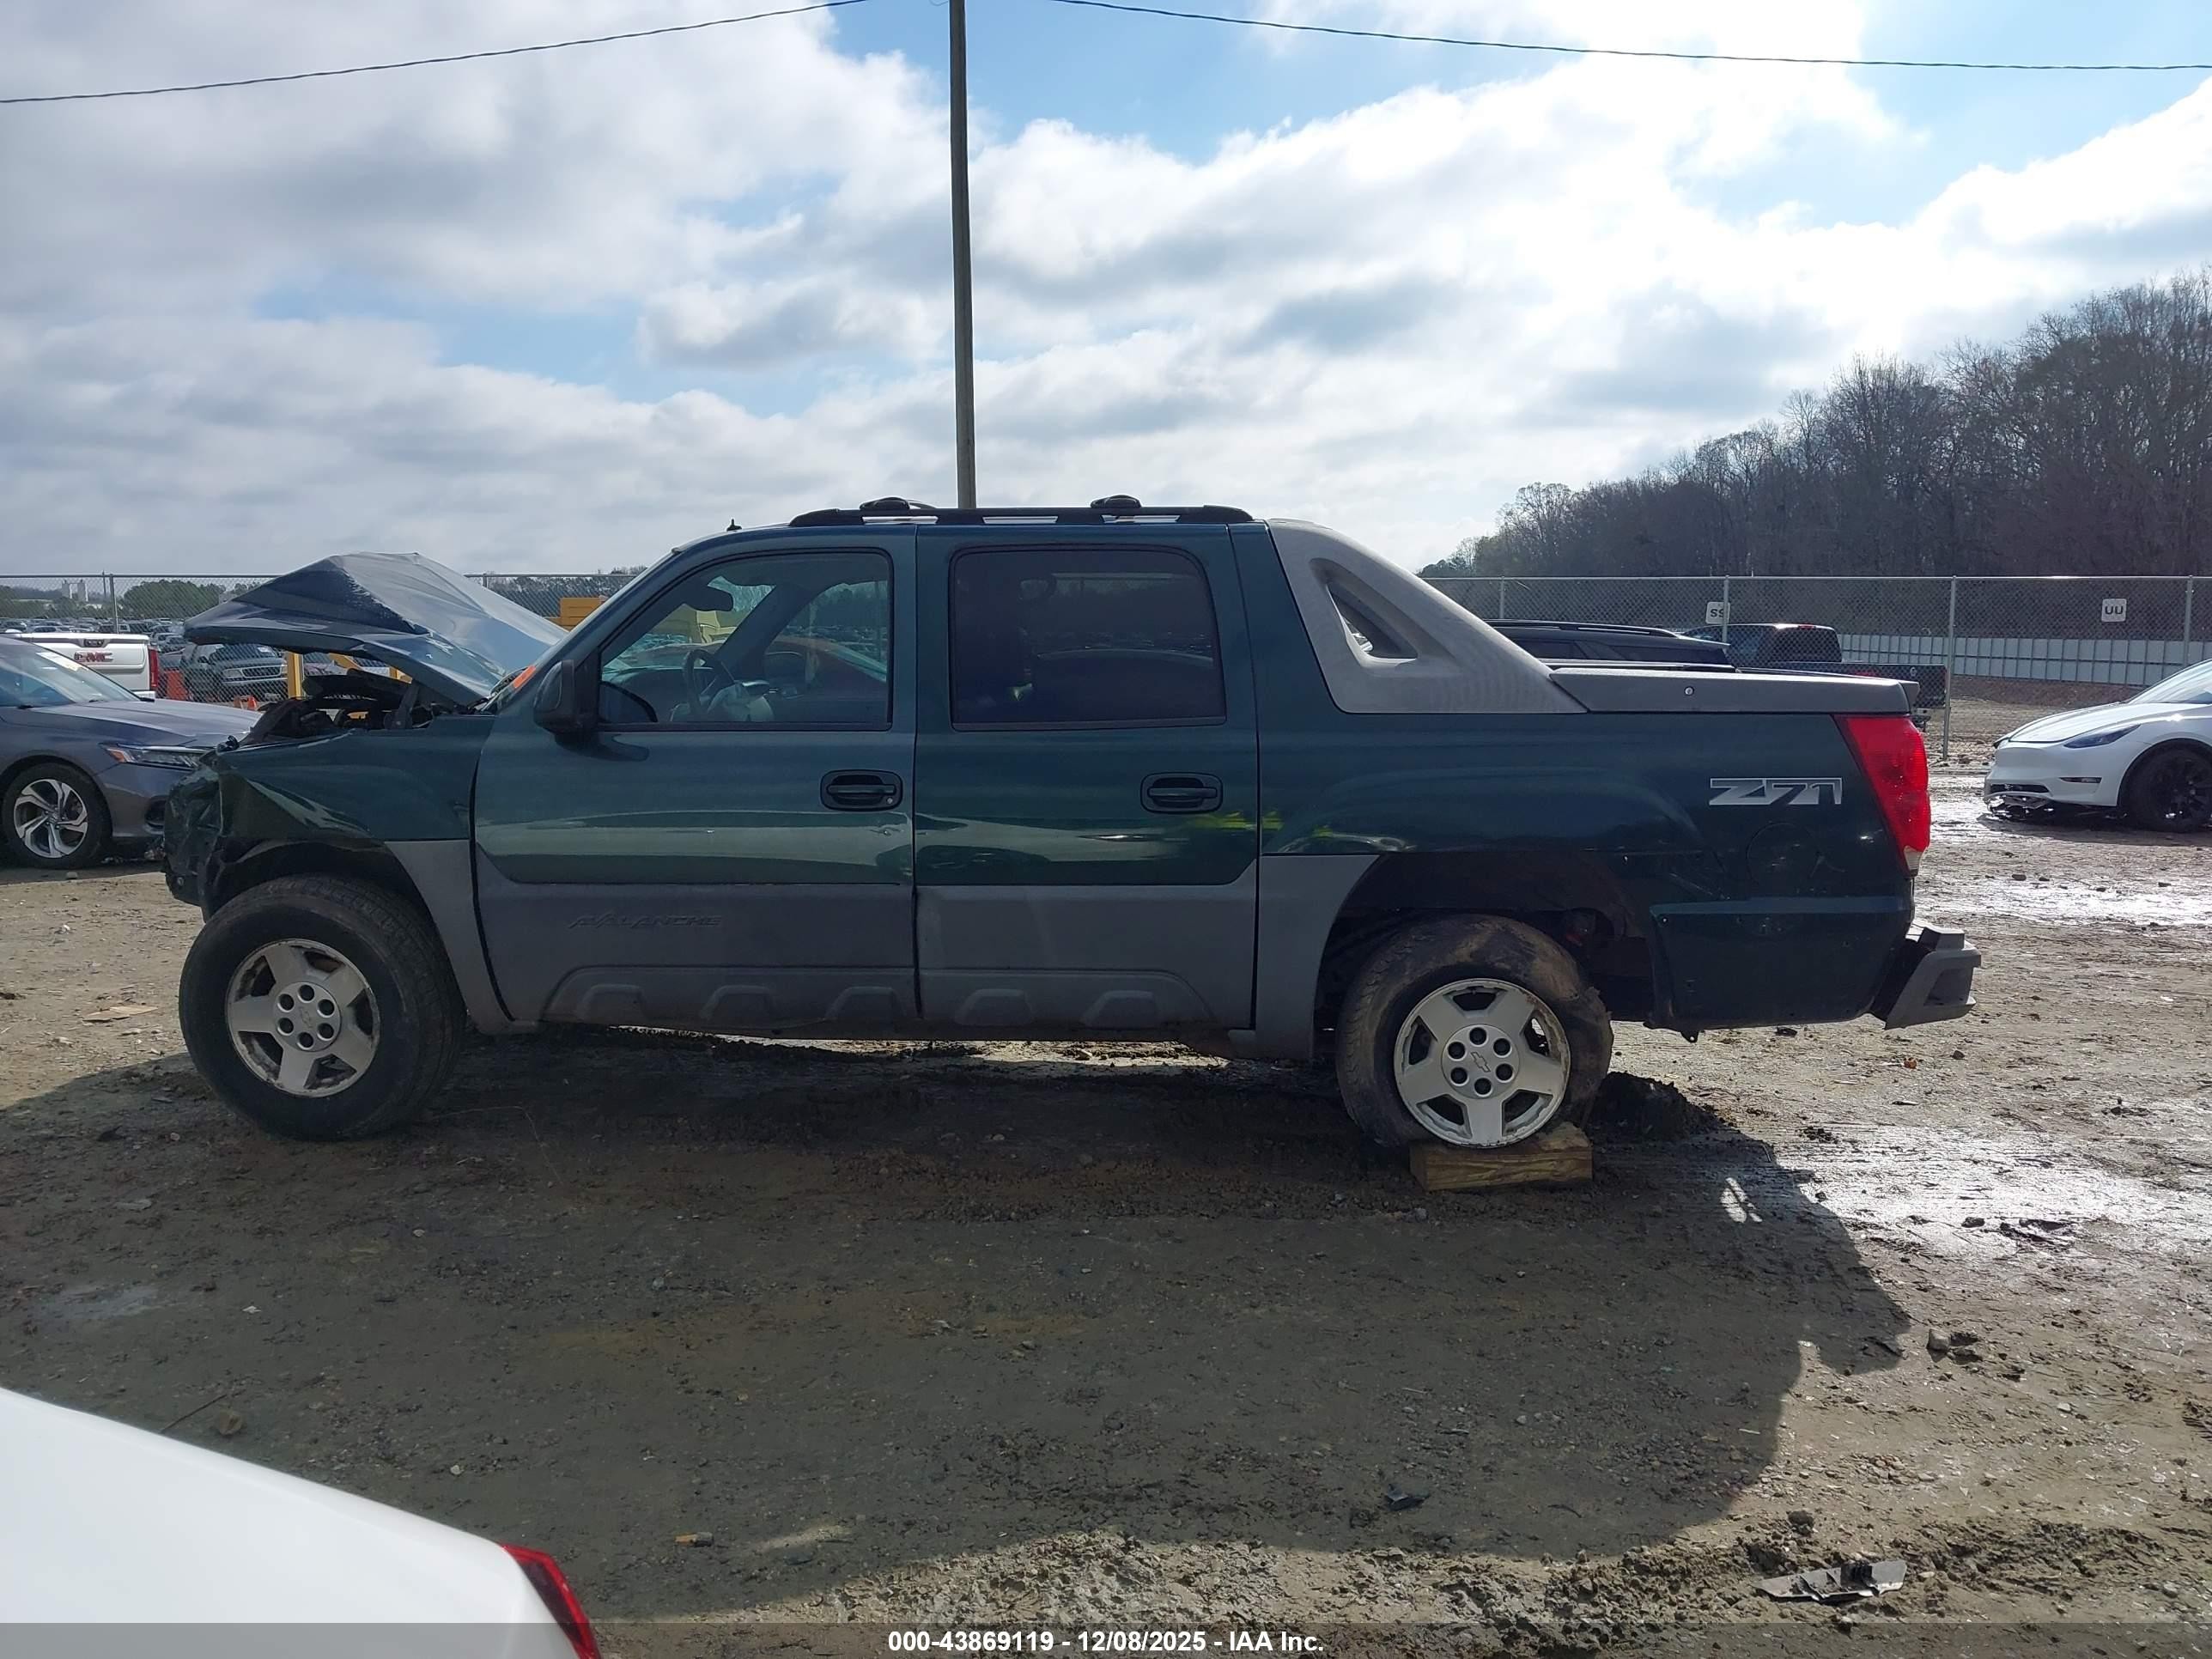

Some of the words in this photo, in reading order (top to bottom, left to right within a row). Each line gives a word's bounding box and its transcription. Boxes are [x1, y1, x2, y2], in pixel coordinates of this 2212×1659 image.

[2105, 605, 2124, 615] UU
[74, 652, 113, 662] GMC
[1709, 777, 1842, 805] Z71
[568, 910, 723, 929] AVALANCHE
